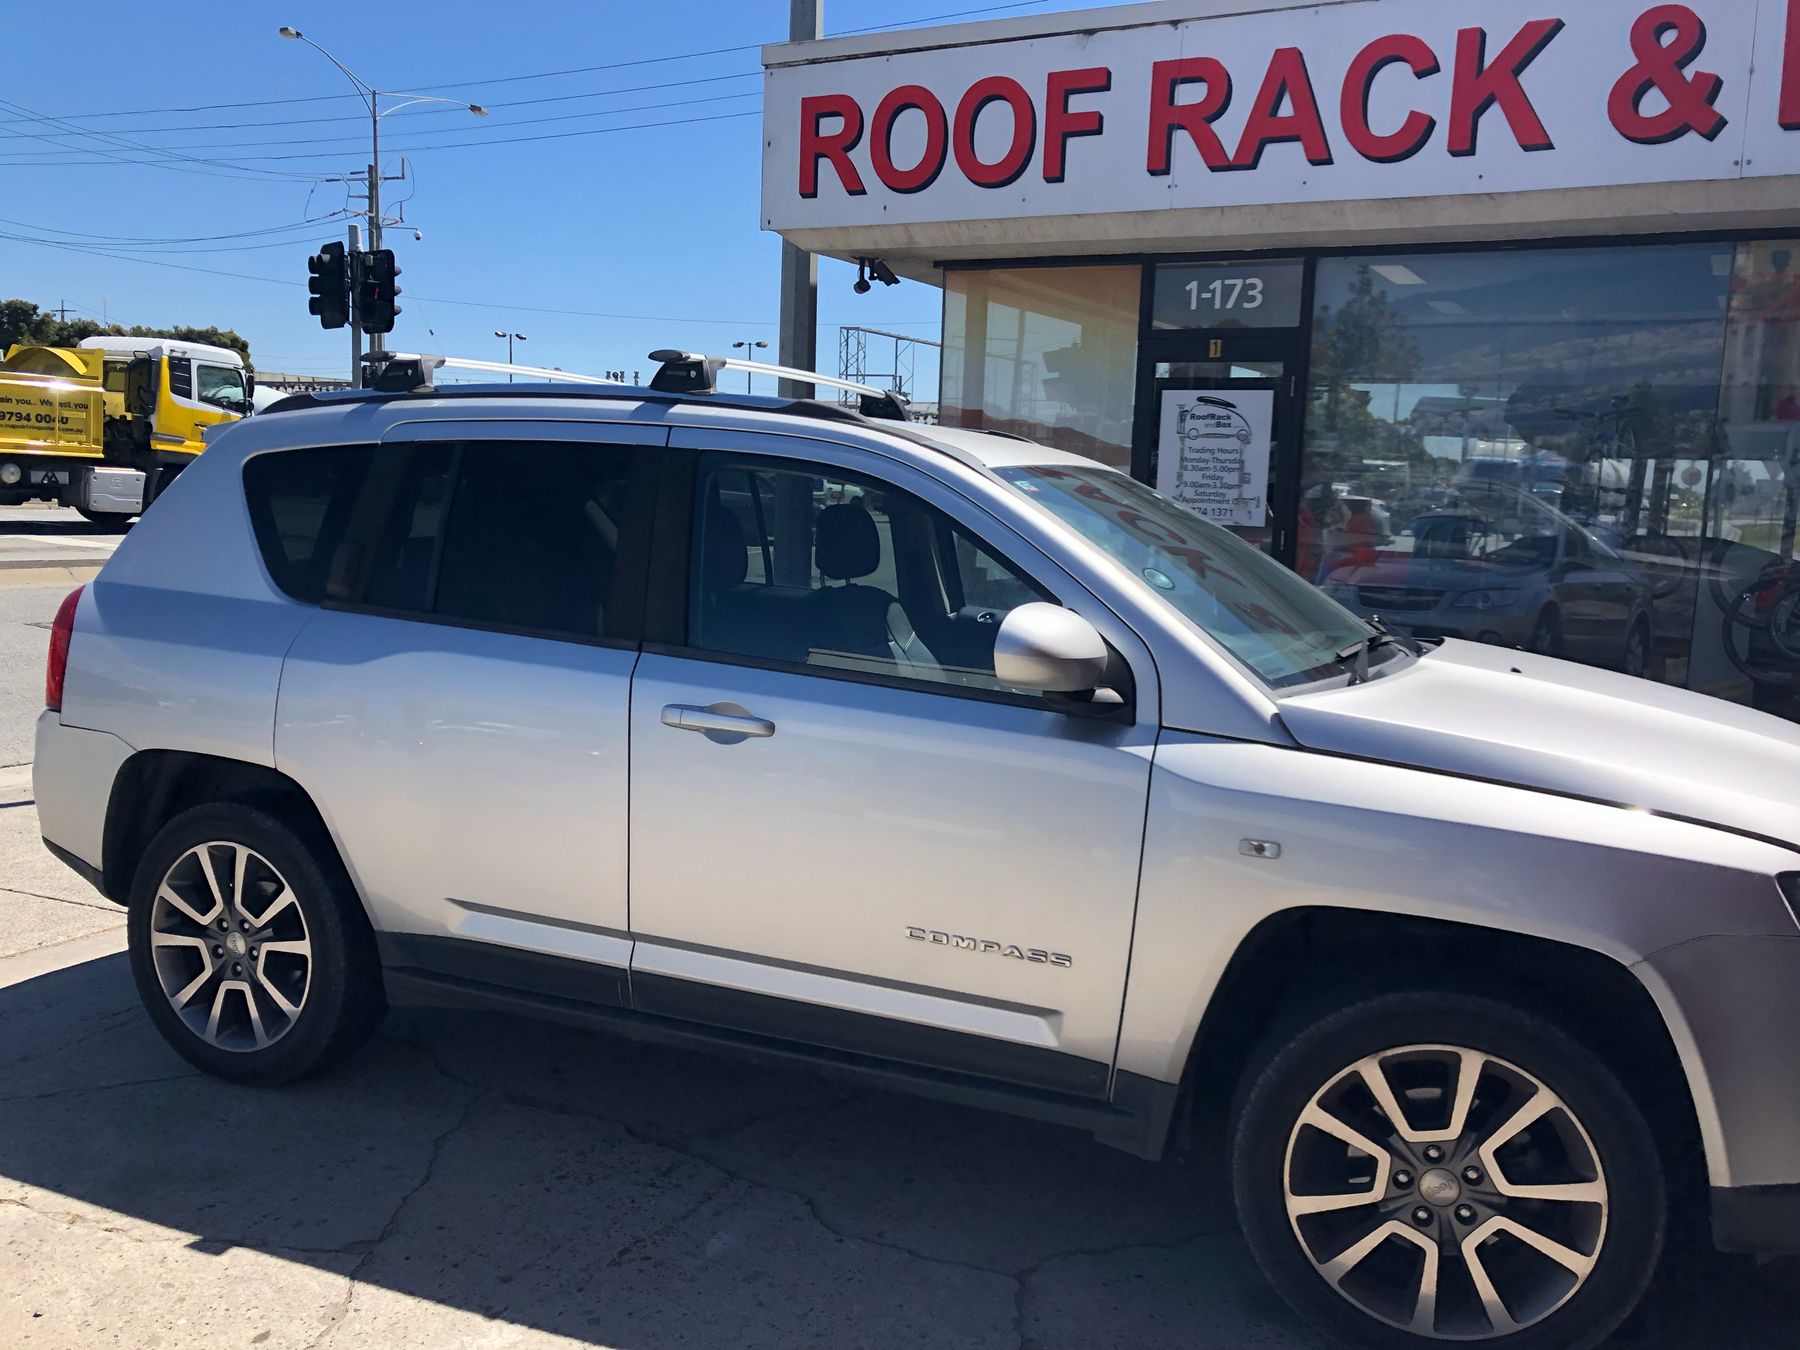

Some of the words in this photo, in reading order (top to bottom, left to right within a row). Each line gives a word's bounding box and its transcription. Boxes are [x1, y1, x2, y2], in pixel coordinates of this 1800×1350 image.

[799, 67, 1111, 199] ROOF
[1147, 18, 1565, 176] RACK
[1608, 3, 1729, 143] &
[1185, 278, 1263, 310] 1-173
[58, 401, 71, 409] est
[74, 401, 88, 409] you
[0, 411, 32, 422] 9794
[1190, 413, 1232, 421] RoofRack
[1188, 446, 1215, 455] Trading
[1217, 447, 1239, 455] Hours
[1201, 474, 1224, 482] Friday
[1194, 490, 1227, 498] Saturday
[1182, 497, 1230, 505] Appointment
[1212, 508, 1233, 517] 1371
[905, 926, 1072, 968] COMPASS
